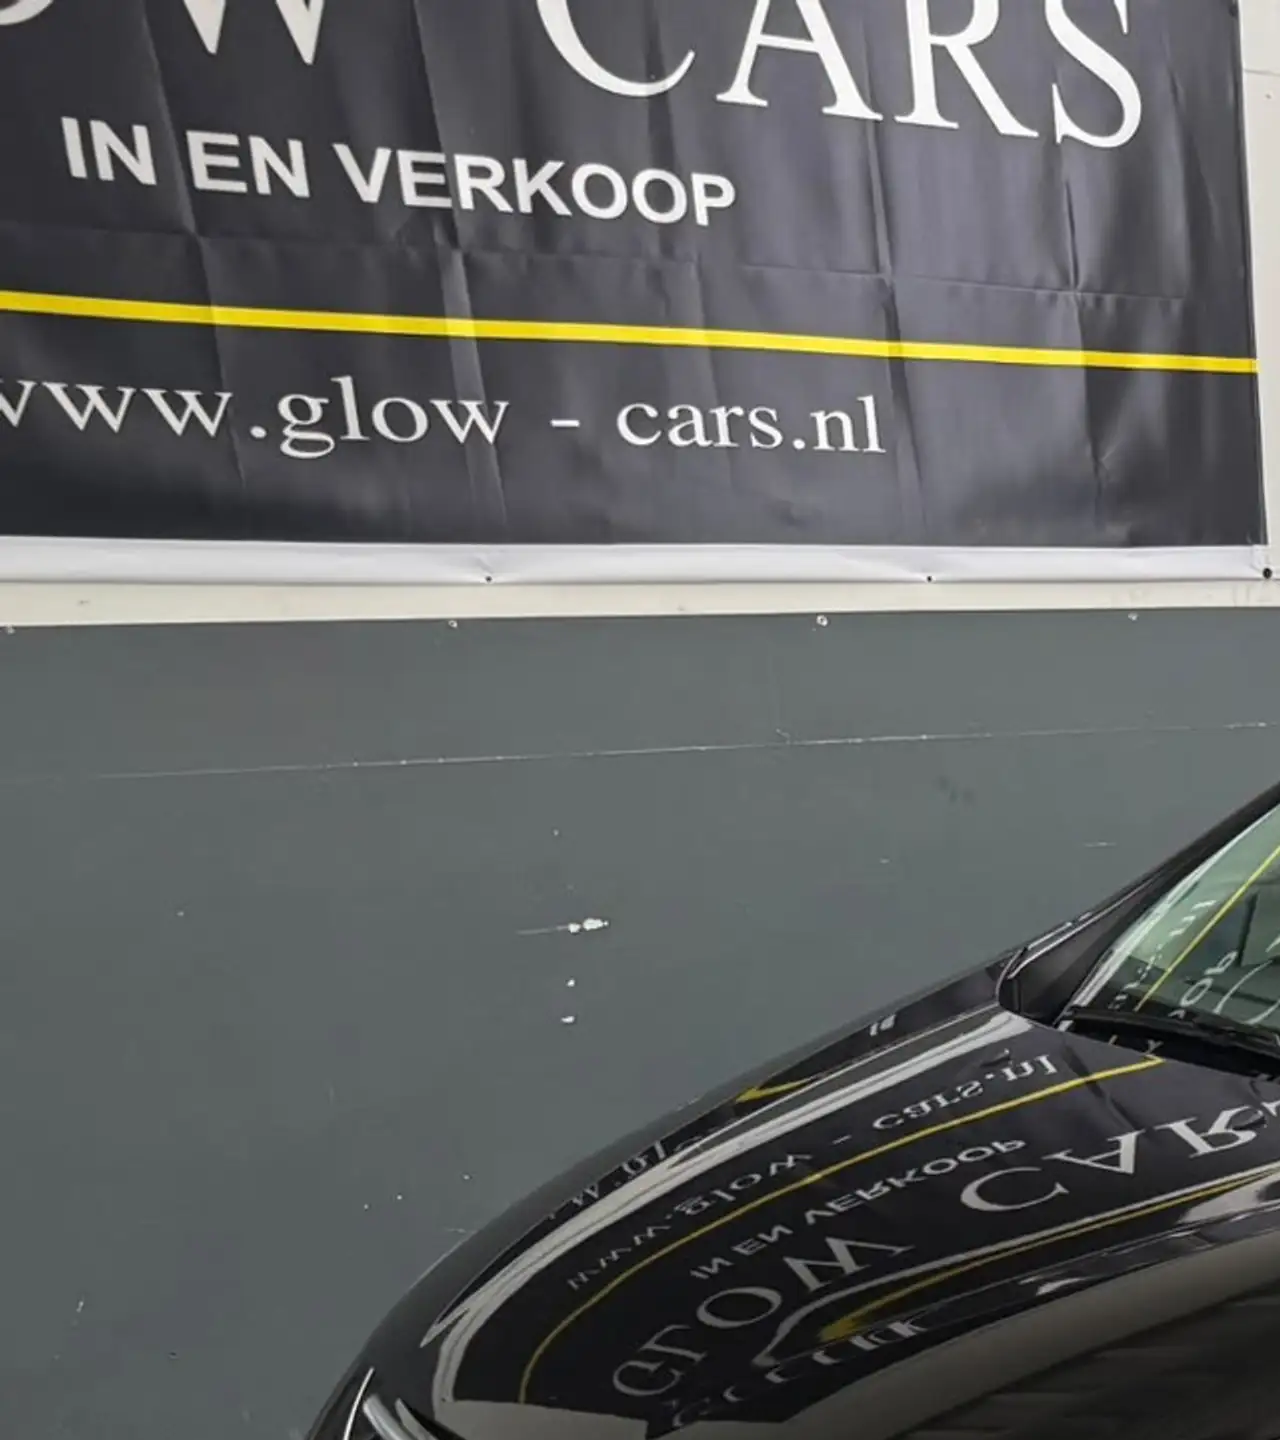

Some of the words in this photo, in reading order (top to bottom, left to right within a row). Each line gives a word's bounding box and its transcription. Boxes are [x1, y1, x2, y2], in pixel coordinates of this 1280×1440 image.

[61, 116, 157, 186] IN
[186, 130, 310, 198] EN
[333, 143, 736, 226] VERKOOP
[616, 394, 887, 454] cars.nl
